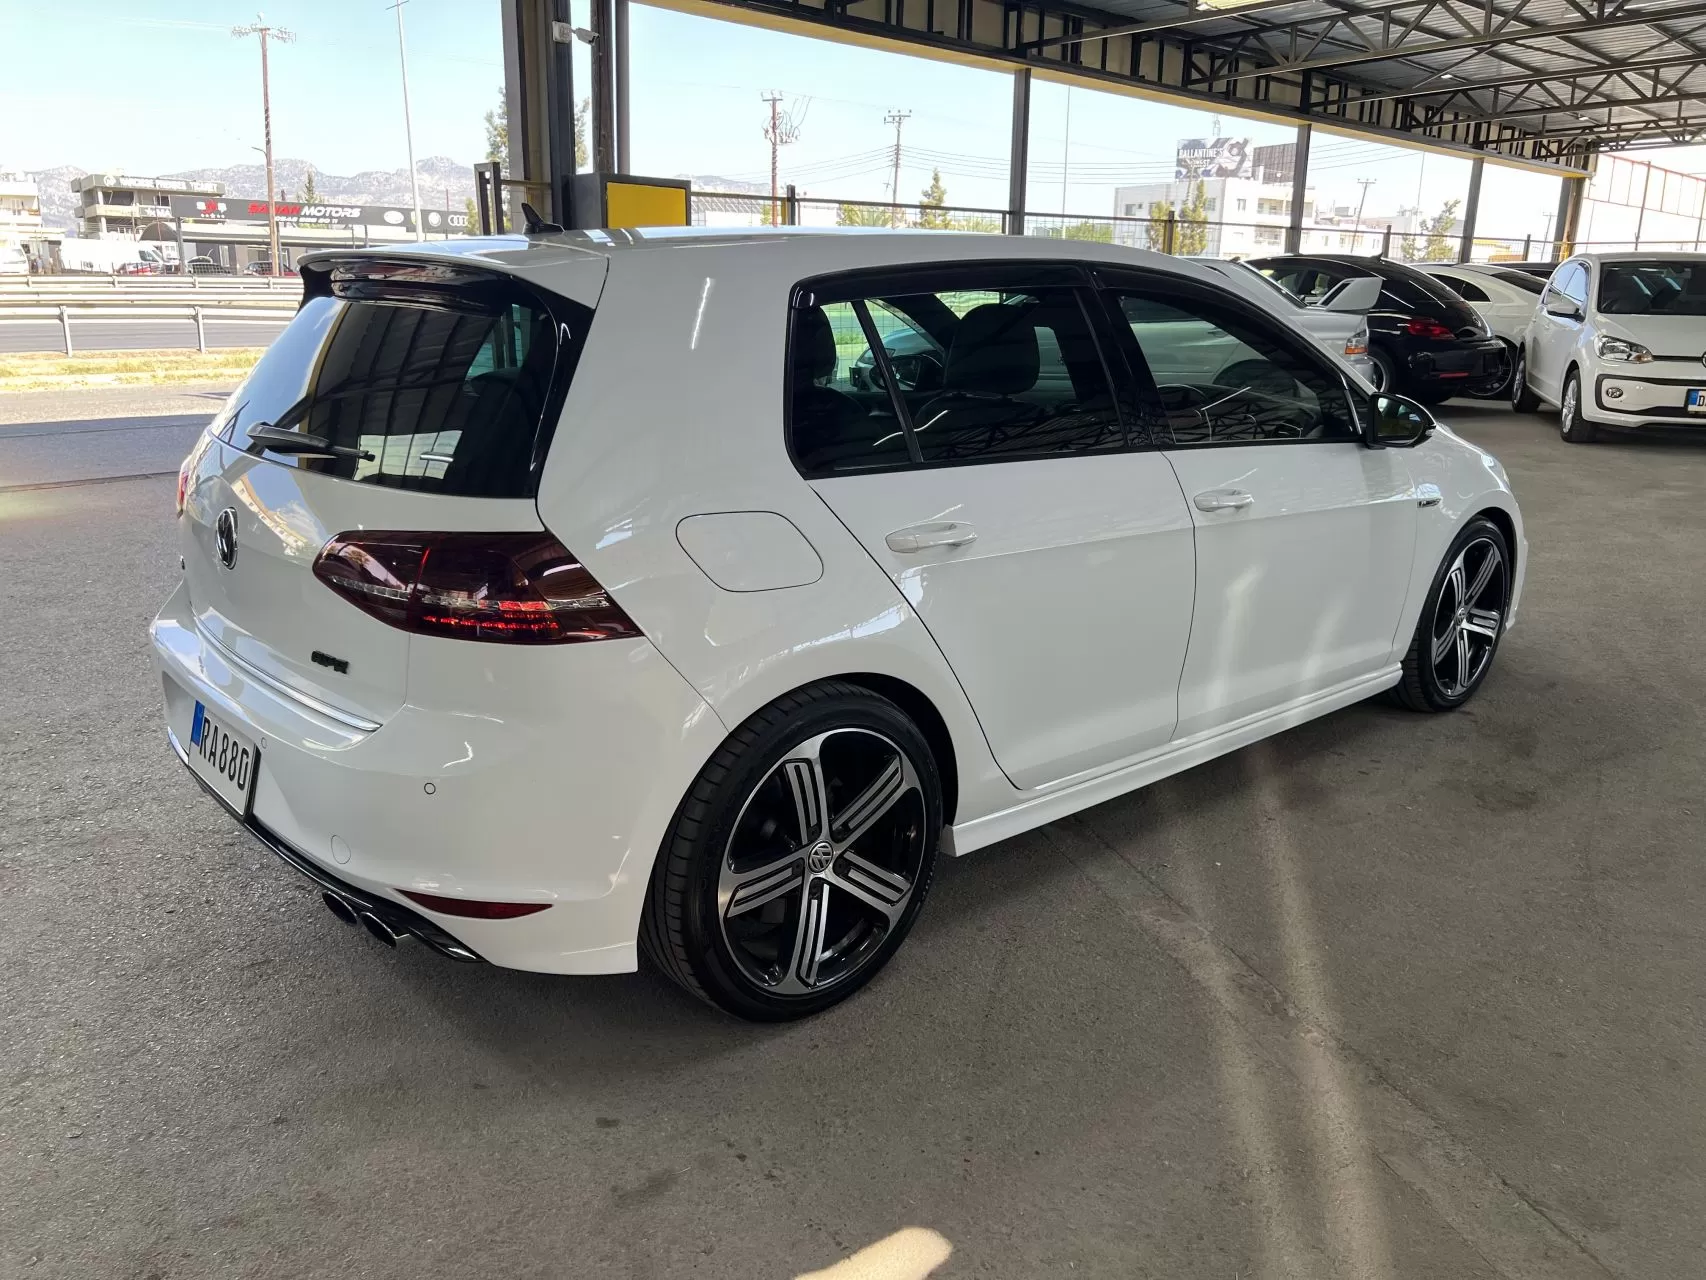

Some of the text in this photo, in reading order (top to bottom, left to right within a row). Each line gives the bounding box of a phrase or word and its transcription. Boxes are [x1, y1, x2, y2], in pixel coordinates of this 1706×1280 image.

[1179, 148, 1223, 158] BALLANTINE'S
[301, 205, 362, 218] MOTORS
[1697, 395, 1706, 407] D
[199, 716, 250, 791] RA880
